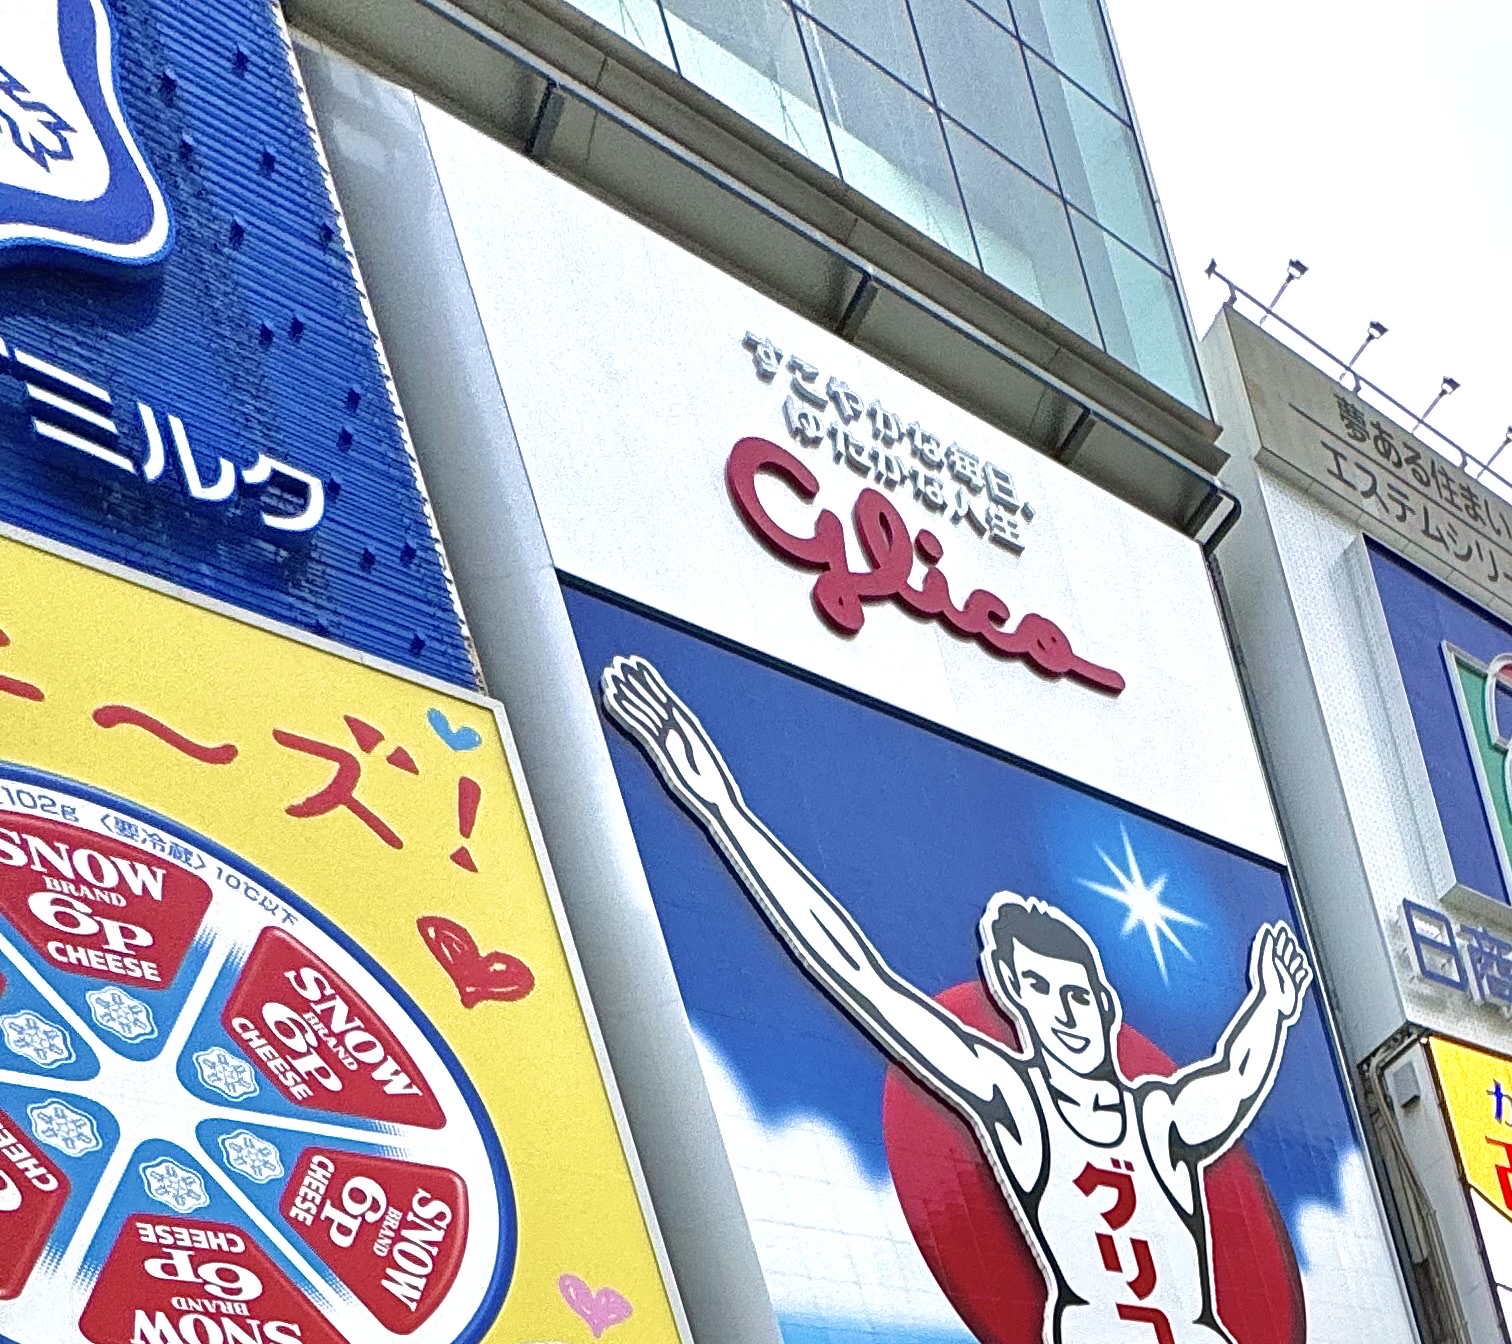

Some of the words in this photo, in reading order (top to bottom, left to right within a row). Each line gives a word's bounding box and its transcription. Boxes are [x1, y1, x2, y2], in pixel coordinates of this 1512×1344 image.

[781, 395, 1027, 558] ゆたかな人生
[724, 436, 1126, 699] Glico
[0, 827, 166, 902] SNOW
[42, 875, 127, 908] BRAND
[46, 940, 162, 983] CHEESE
[231, 1017, 315, 1101] CHEESE
[283, 967, 424, 1097] SNOW
[302, 1010, 359, 1071] BRAND
[289, 1154, 336, 1227] CHEESE
[135, 1222, 246, 1254] CHEESE
[372, 1206, 404, 1257] BRAND
[381, 1187, 453, 1312] SNOW
[170, 1296, 250, 1317] BRAND
